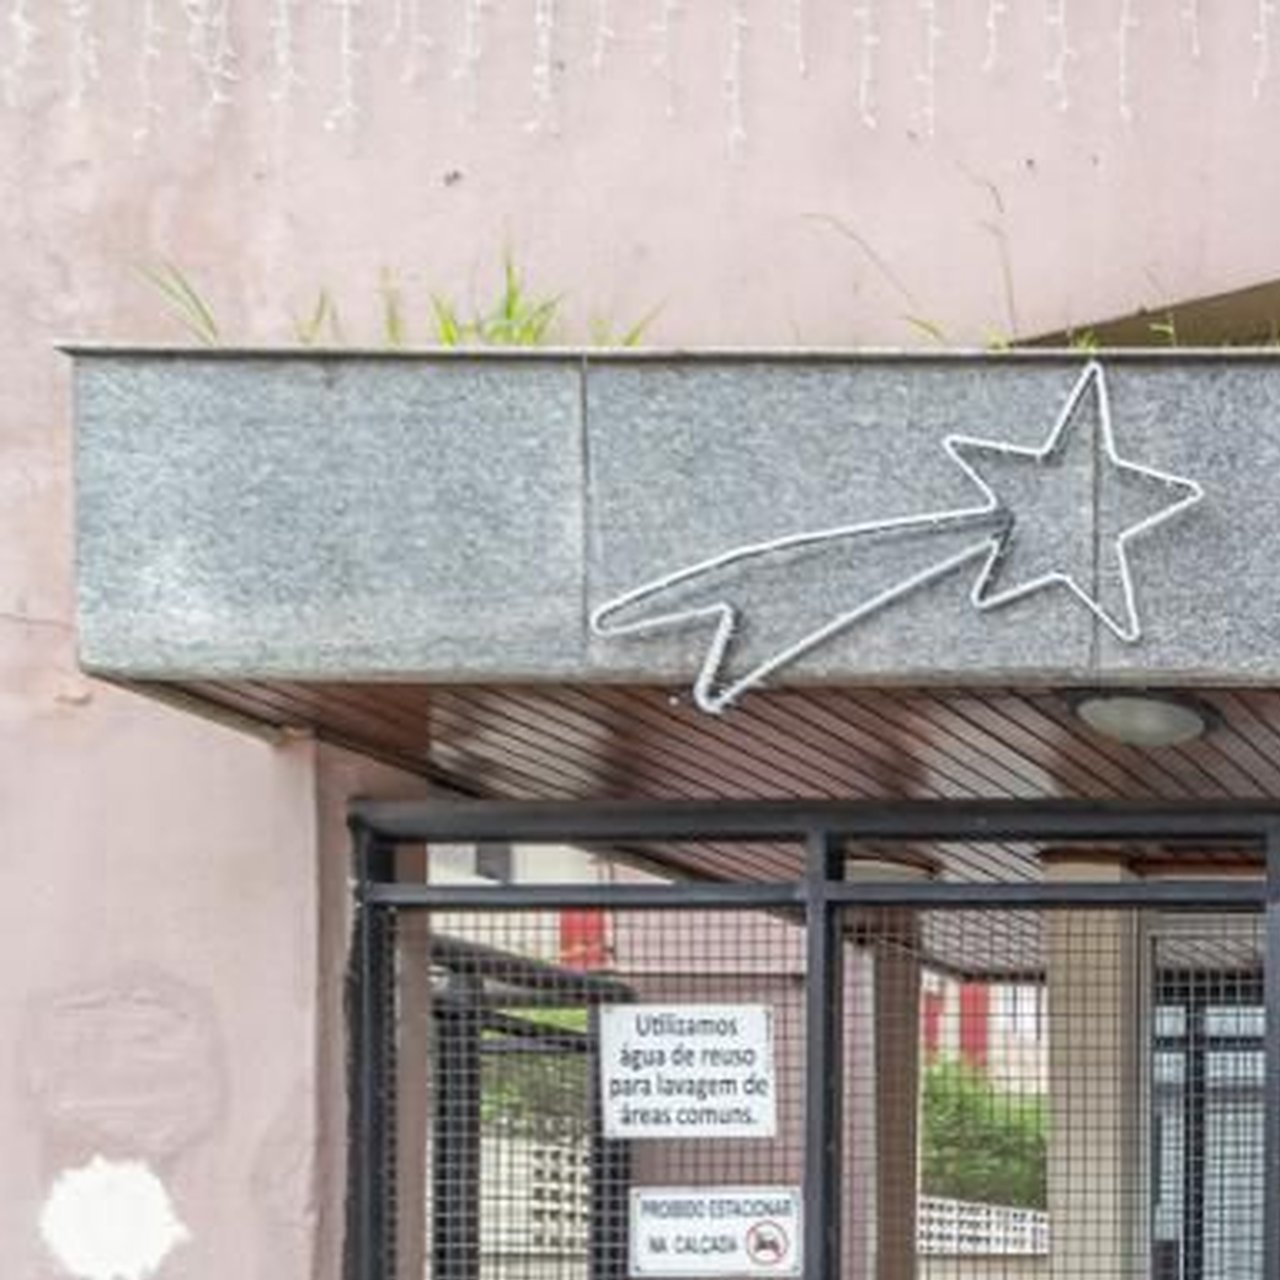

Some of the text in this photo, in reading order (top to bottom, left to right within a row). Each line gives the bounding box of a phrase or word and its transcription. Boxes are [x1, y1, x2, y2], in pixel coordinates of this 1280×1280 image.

[636, 1013, 738, 1037] Utilizamos
[619, 1042, 757, 1072] água de reuso
[609, 1073, 769, 1100] para lavagem de
[620, 1103, 759, 1125] áreas comuns.
[641, 1198, 793, 1218] PROIBIDO ESTACIONAR
[649, 1234, 668, 1253] NA
